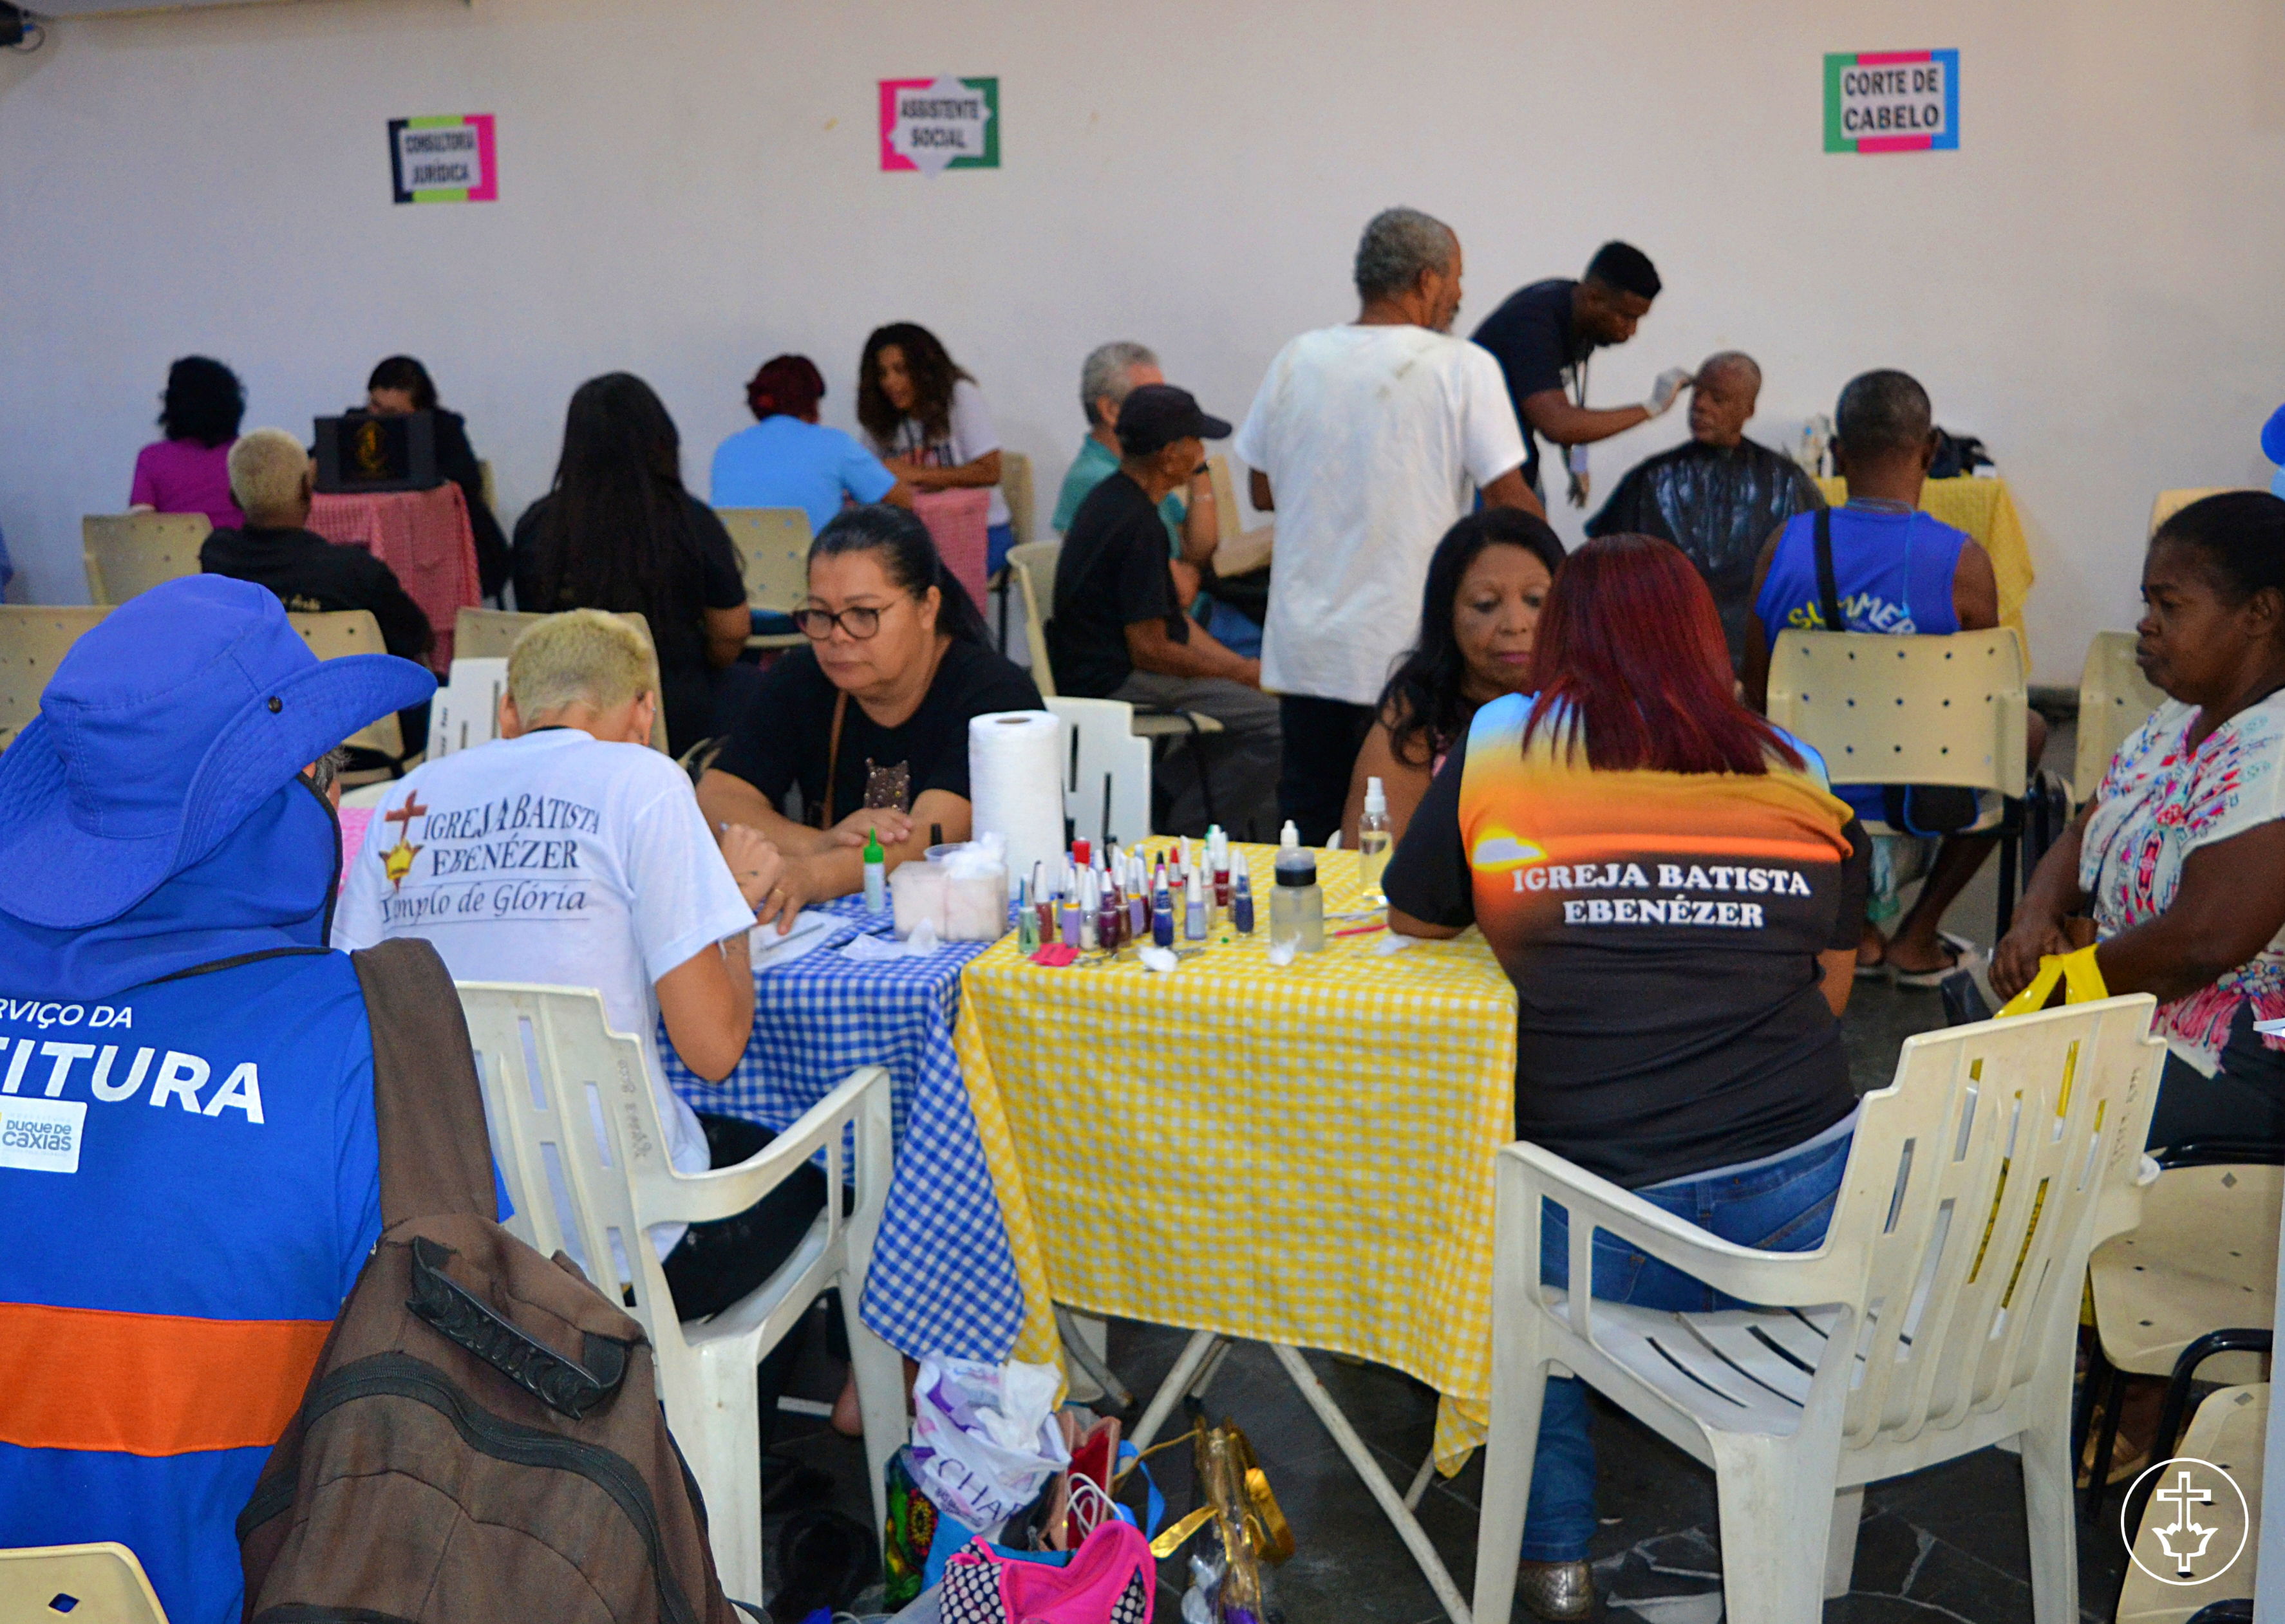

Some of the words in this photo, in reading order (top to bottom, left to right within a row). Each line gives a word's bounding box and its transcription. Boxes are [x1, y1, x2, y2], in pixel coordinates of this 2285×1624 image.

[1845, 70, 1906, 95] CORTE
[1913, 68, 1937, 93] DE
[1844, 104, 1939, 131] CABELO
[911, 127, 966, 148] SOCIAL
[424, 797, 509, 841] IGREJA
[511, 793, 601, 835] BATISTA
[431, 832, 580, 877] EBENÉZER
[1512, 863, 1650, 892] IGREJA
[1658, 864, 1812, 897] BATISTA
[458, 882, 485, 913] de
[494, 880, 587, 917] Glória
[1563, 893, 1765, 928] EBENÉZER
[89, 1005, 133, 1029] DA
[0, 1036, 265, 1125] ITURA
